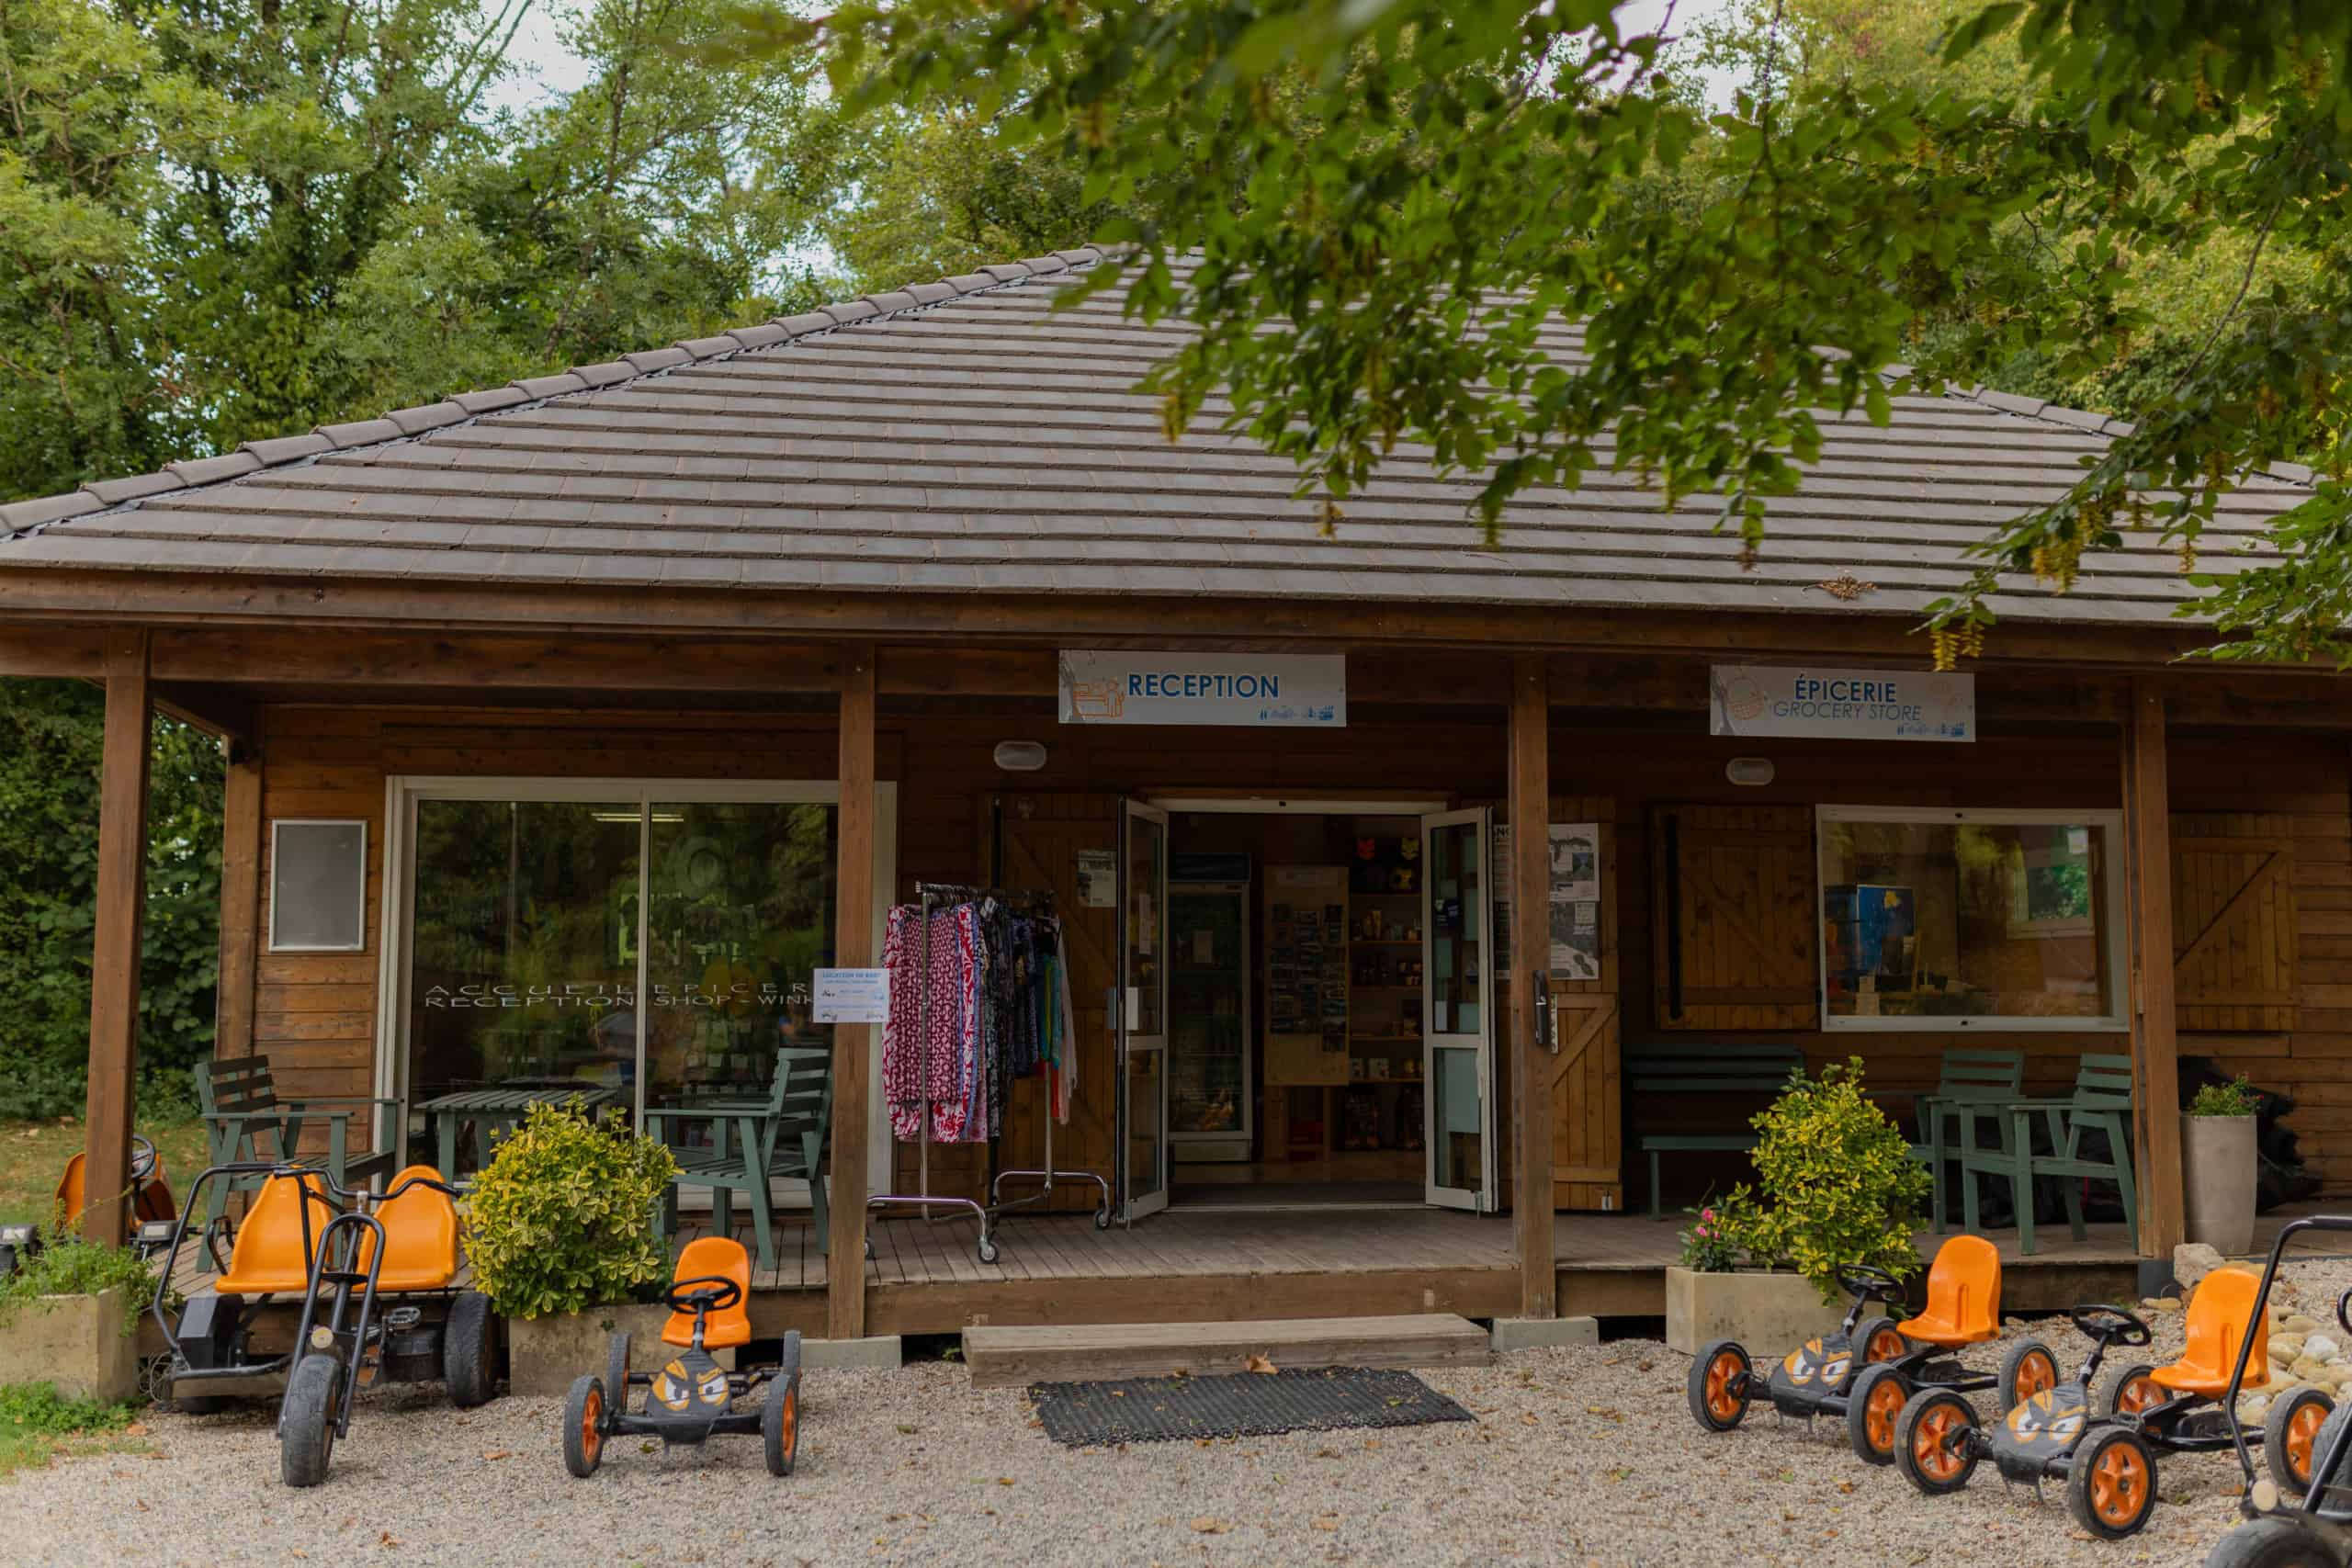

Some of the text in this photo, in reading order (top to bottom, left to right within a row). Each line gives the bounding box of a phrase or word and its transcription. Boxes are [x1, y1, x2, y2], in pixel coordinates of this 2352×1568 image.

[1127, 673, 1280, 698] RECEPTION
[1794, 673, 1897, 703] ÉPICERIE
[1773, 701, 1922, 721] GROCERY STORE
[425, 983, 808, 996] ACCUEIL EPICER
[425, 996, 634, 1008] RECEPTION
[653, 995, 731, 1007] SHOP
